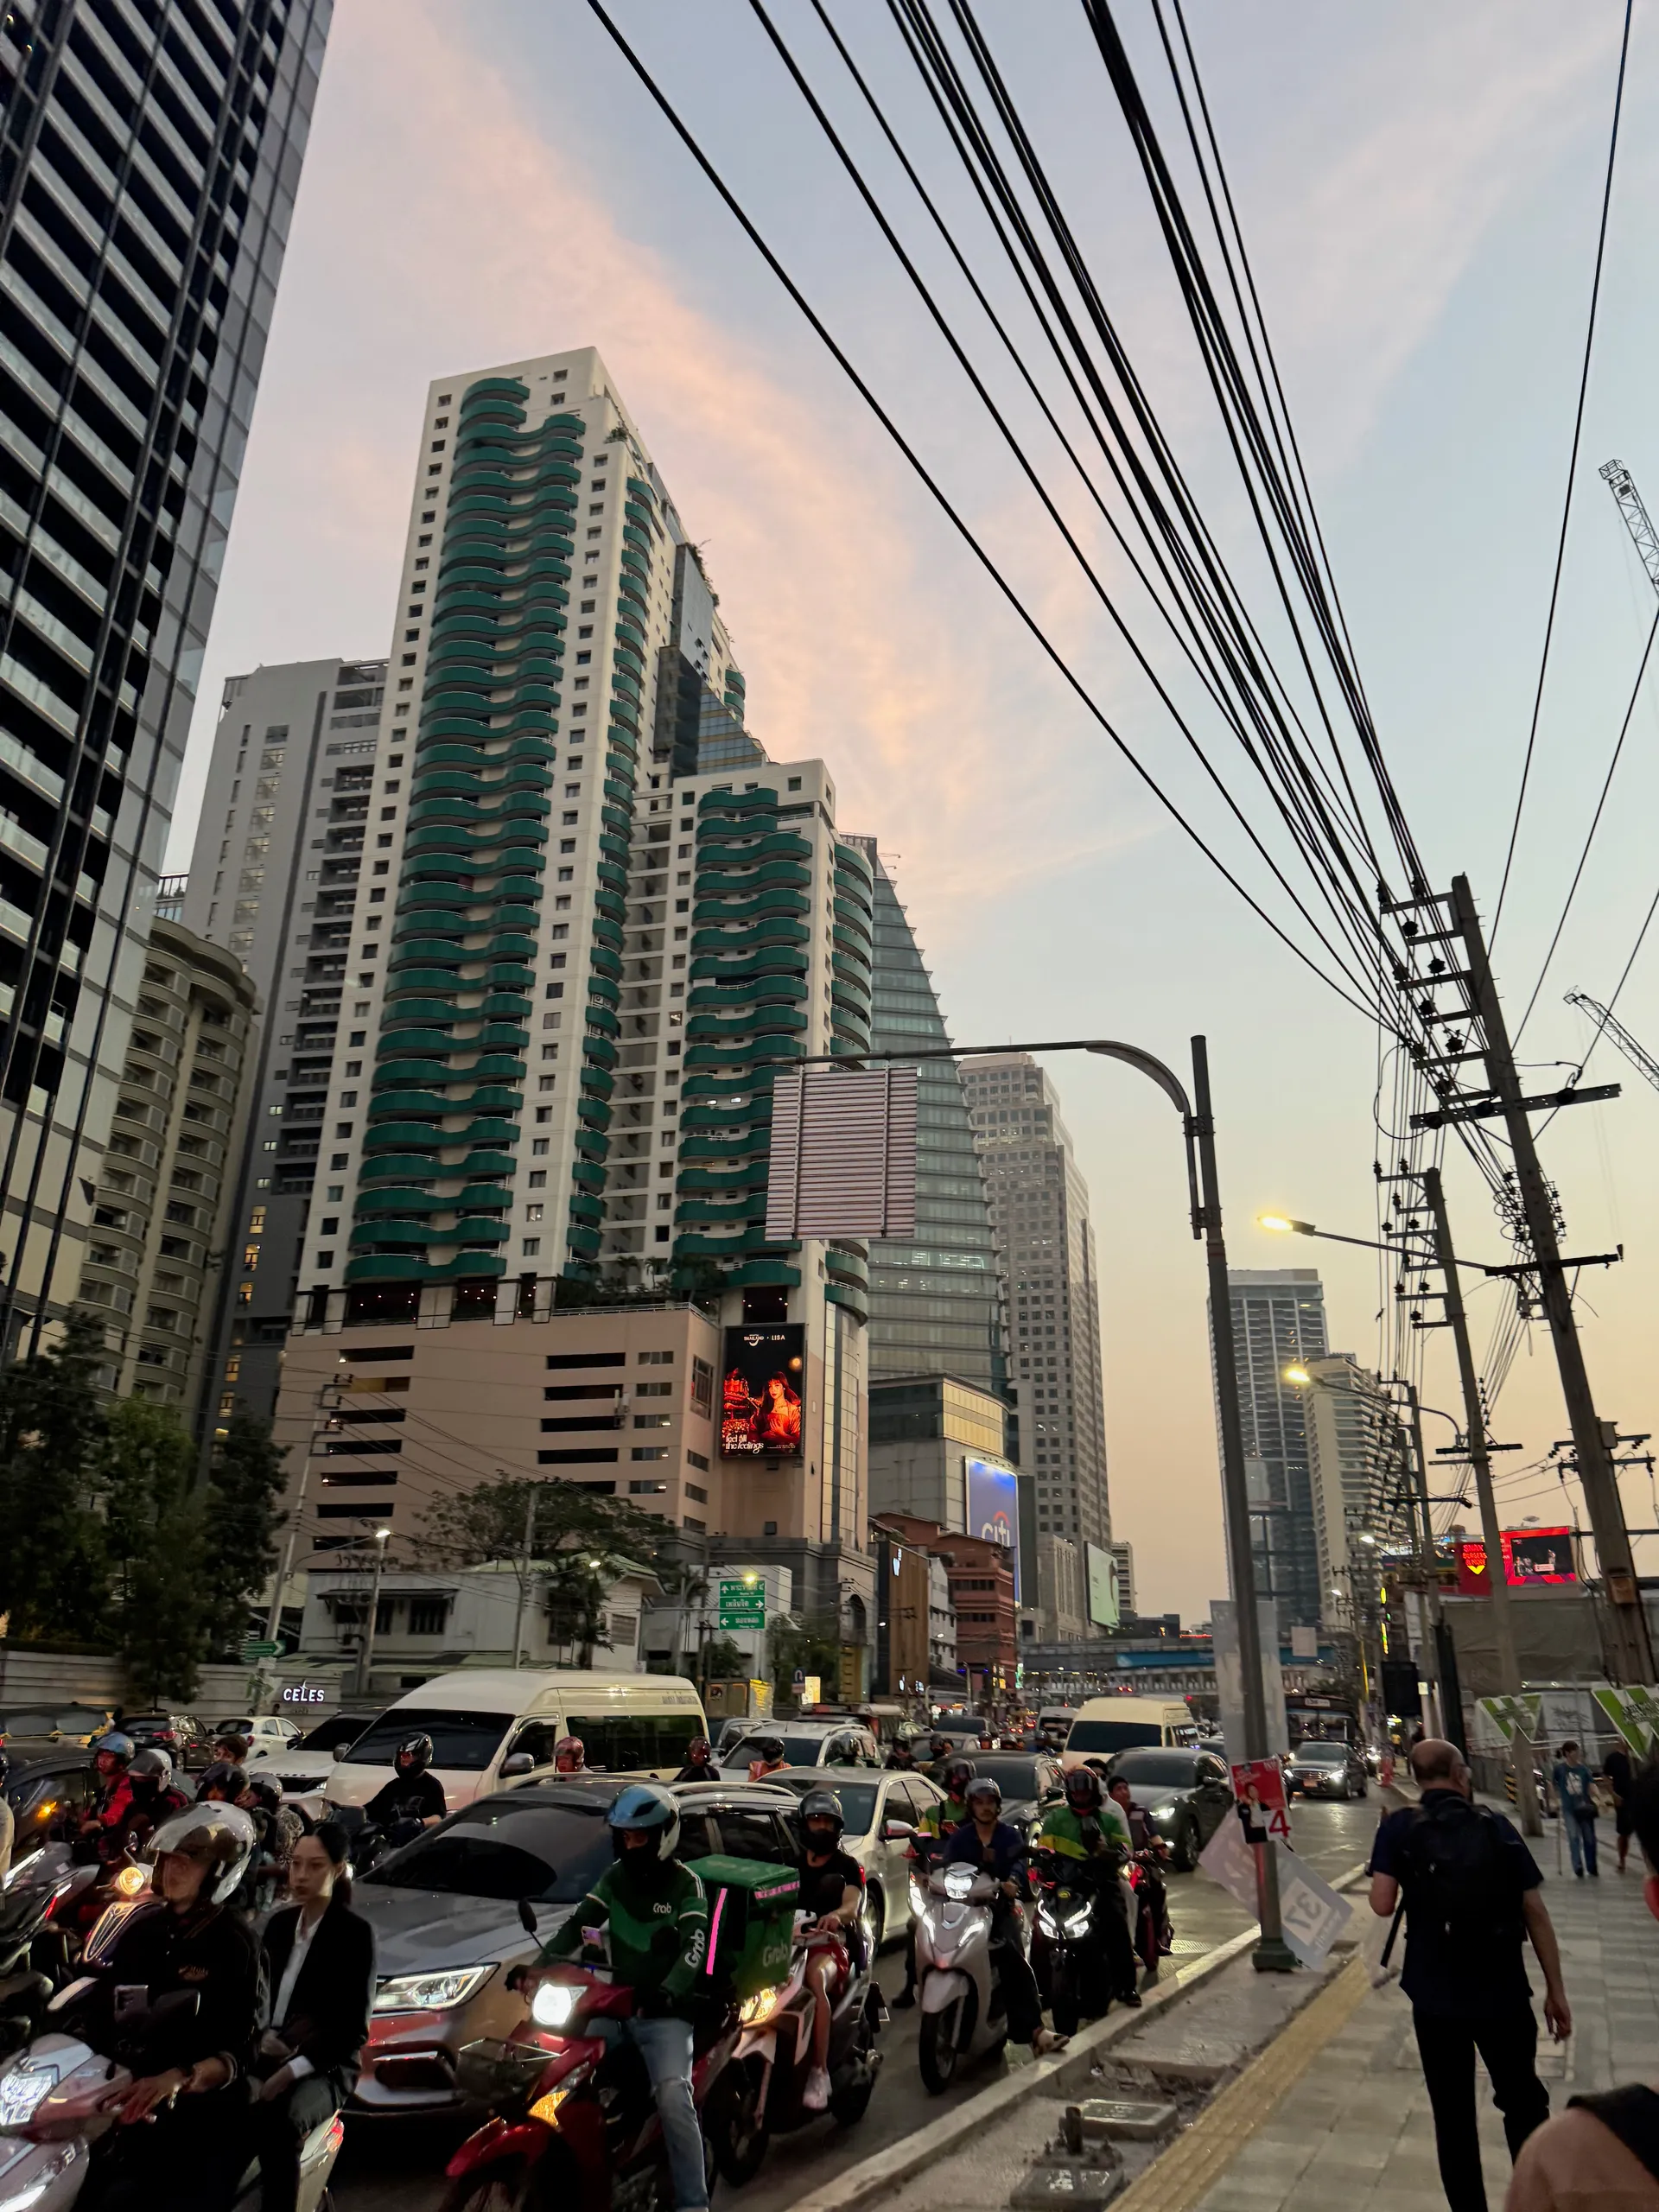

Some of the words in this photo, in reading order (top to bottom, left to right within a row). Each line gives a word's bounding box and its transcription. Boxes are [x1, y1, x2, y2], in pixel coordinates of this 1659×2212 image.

[737, 1441, 765, 1454] feelings
[283, 1685, 325, 1702] CELES
[1268, 1809, 1292, 1838] 4
[652, 1903, 672, 1914] Grab
[684, 1928, 706, 1968] Grab
[762, 1938, 789, 1967] Grab
